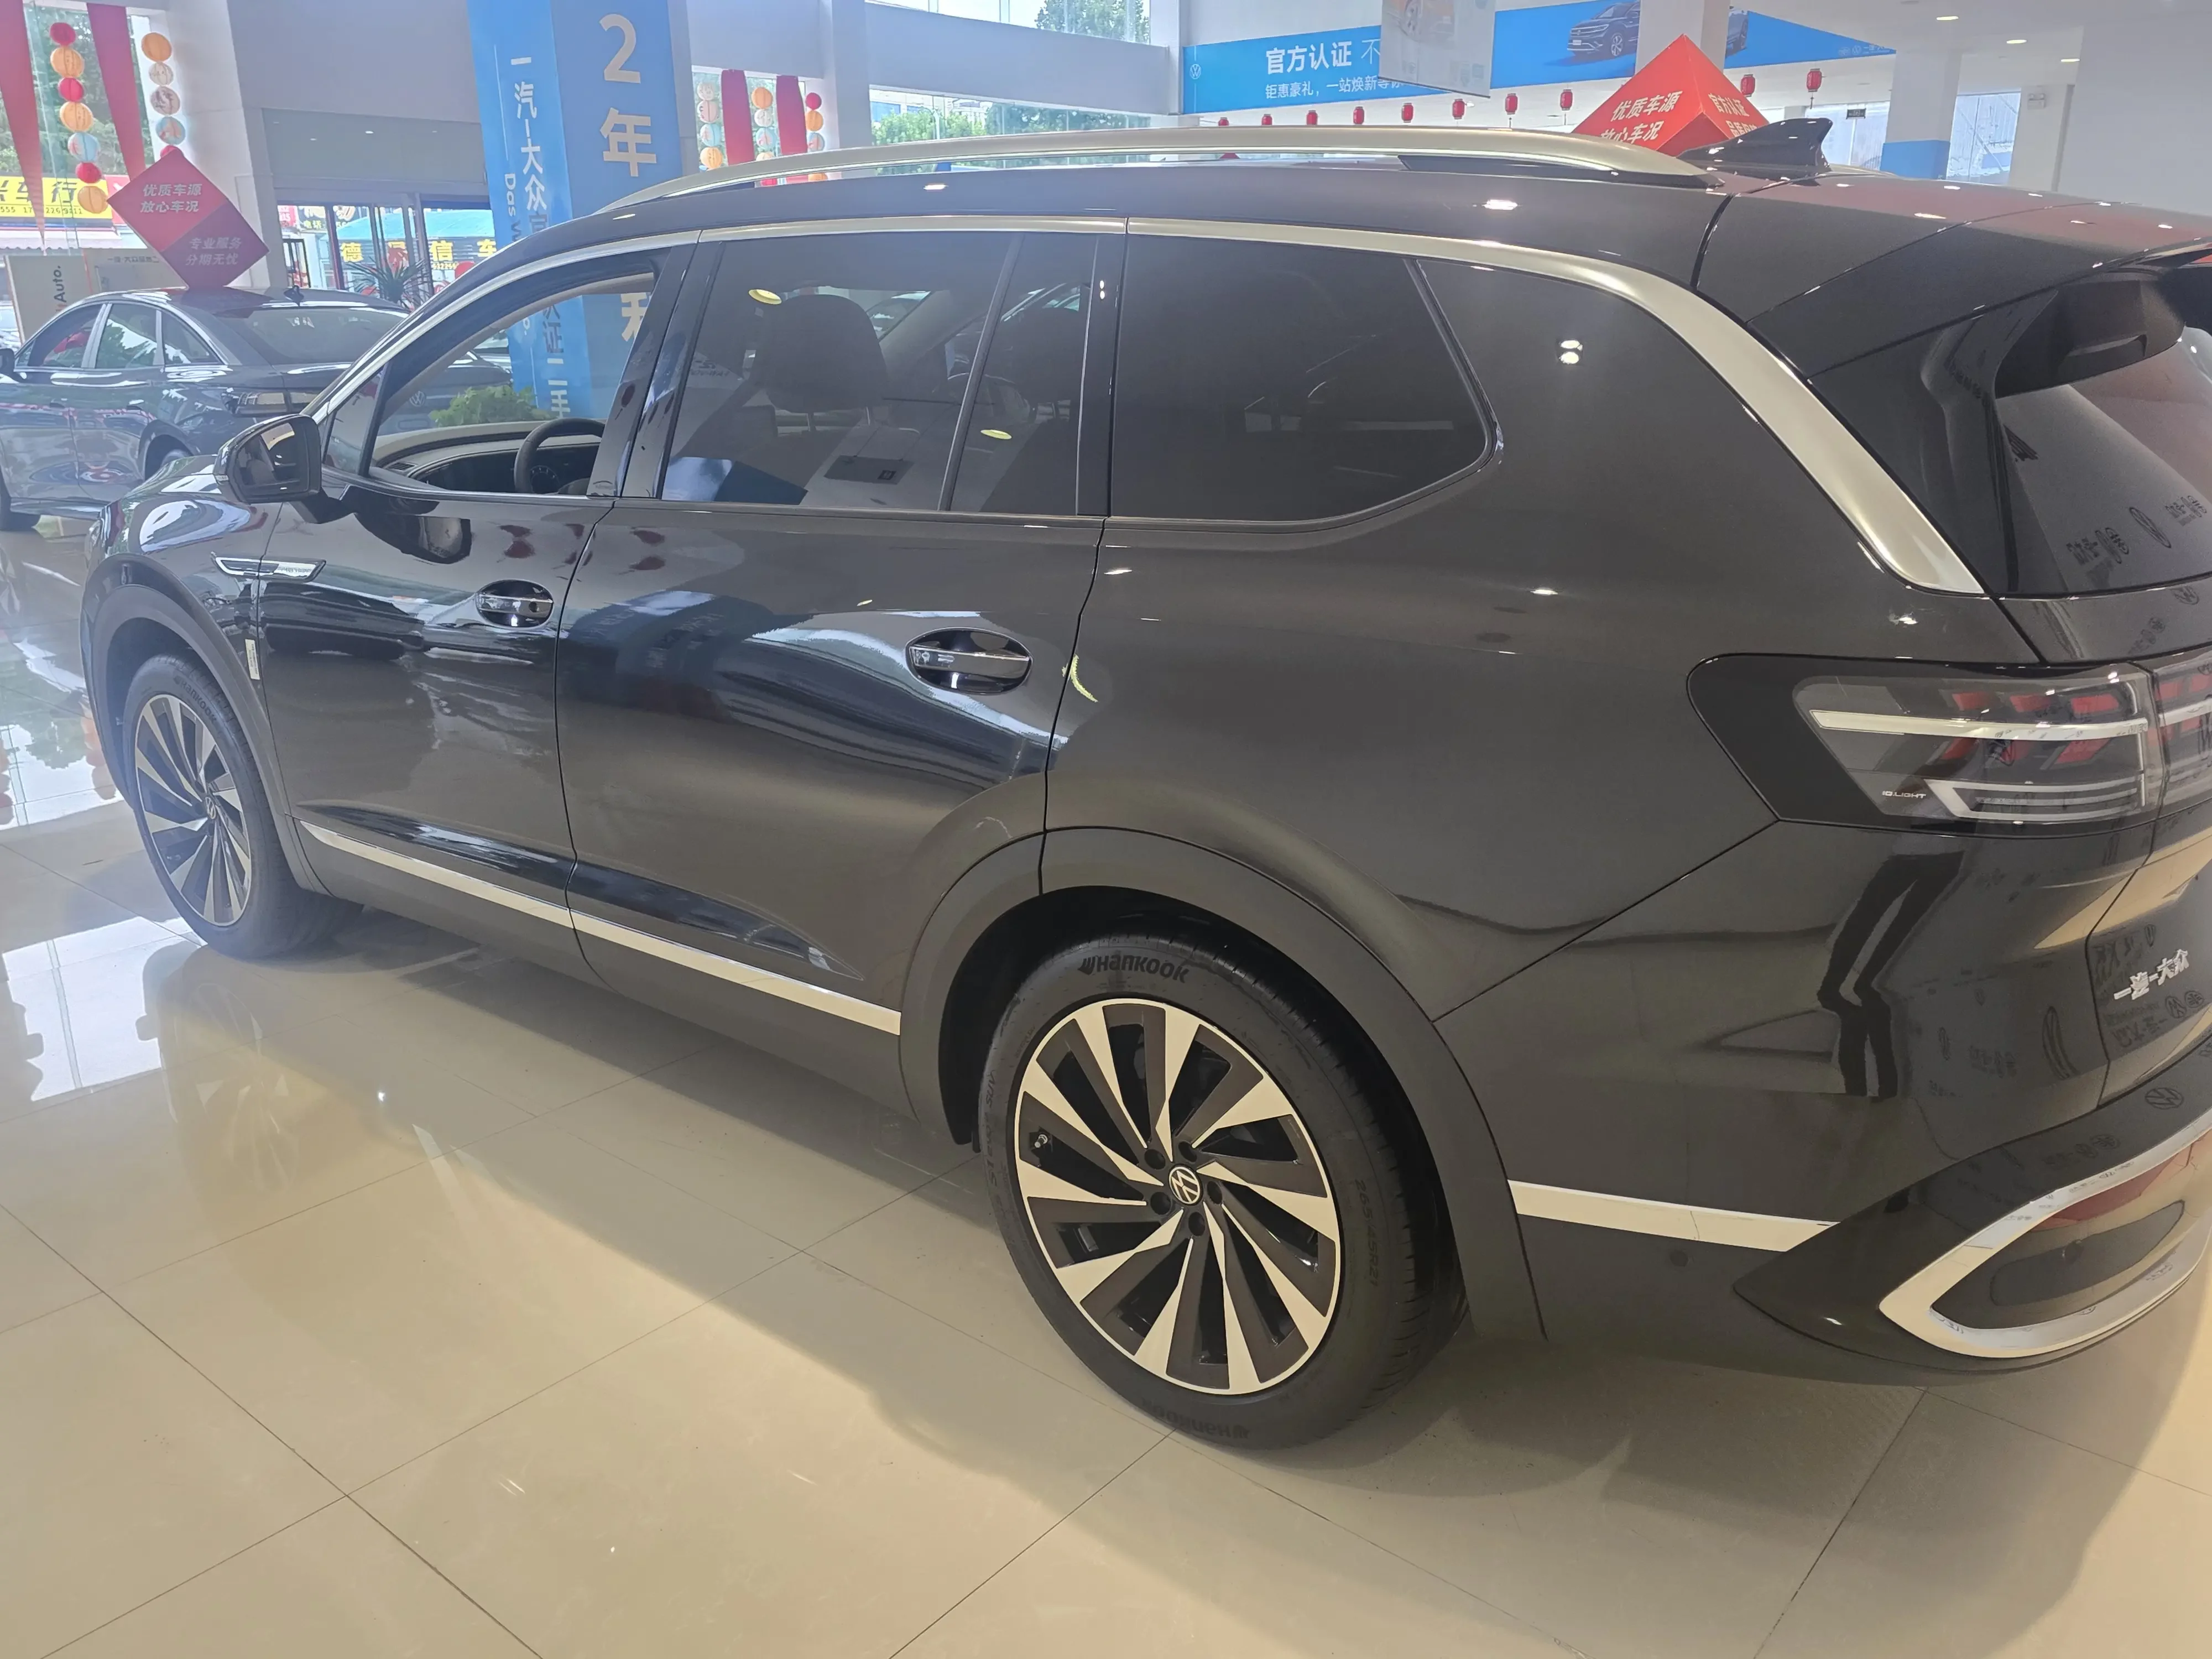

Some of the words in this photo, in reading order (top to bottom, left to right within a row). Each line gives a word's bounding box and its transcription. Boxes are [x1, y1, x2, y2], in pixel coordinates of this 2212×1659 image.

[1265, 41, 1352, 75] 官方认证
[1610, 90, 1683, 122] 优质车源
[1708, 93, 1750, 117] 官方认证
[143, 184, 202, 196] 优质车源
[504, 173, 517, 217] Das
[140, 200, 200, 213] 放心车况
[189, 237, 242, 249] 专业服务
[185, 253, 239, 265] 分期无忧
